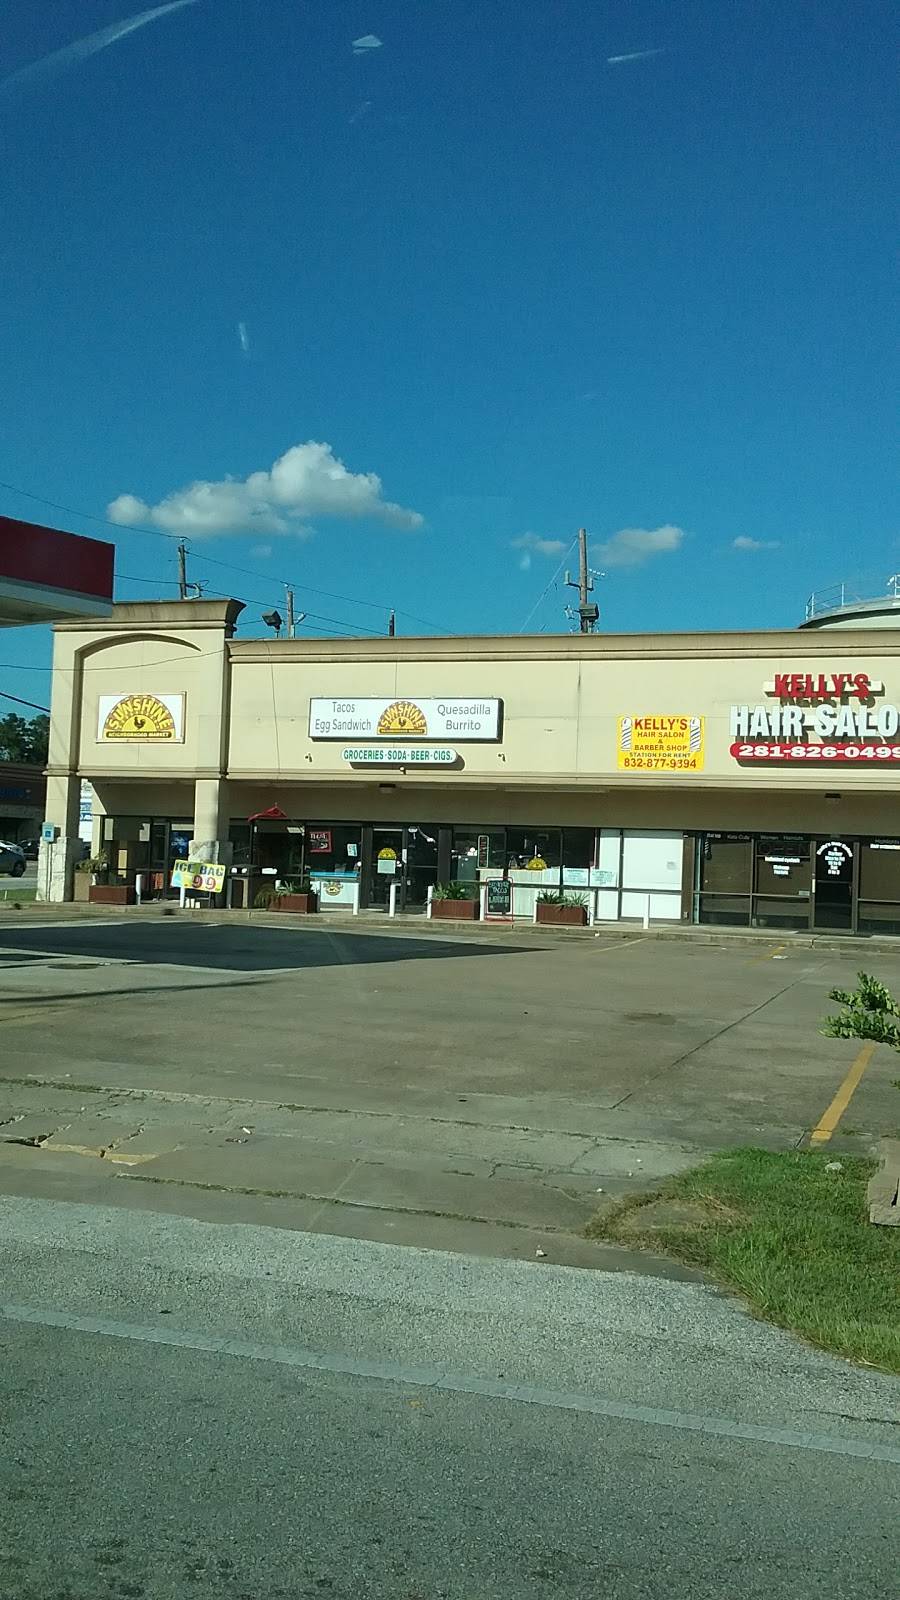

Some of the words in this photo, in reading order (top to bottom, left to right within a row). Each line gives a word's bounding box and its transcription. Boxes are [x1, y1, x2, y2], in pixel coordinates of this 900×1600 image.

[775, 673, 869, 698] KELLY'S
[109, 698, 173, 729] SUNSHINE
[332, 702, 355, 713] Tacos
[437, 704, 491, 716] Quesadilla
[381, 704, 425, 728] SUNSHINE
[730, 705, 803, 737] HAIR
[315, 719, 331, 733] Egg
[332, 718, 372, 731] Sandwich
[445, 719, 481, 731] Burrito
[634, 718, 688, 731] KELLY'S
[739, 746, 900, 758] 281-826-0499
[624, 758, 697, 770] 832-877-9394
[174, 862, 194, 874] ICE
[199, 865, 223, 877] BAG
